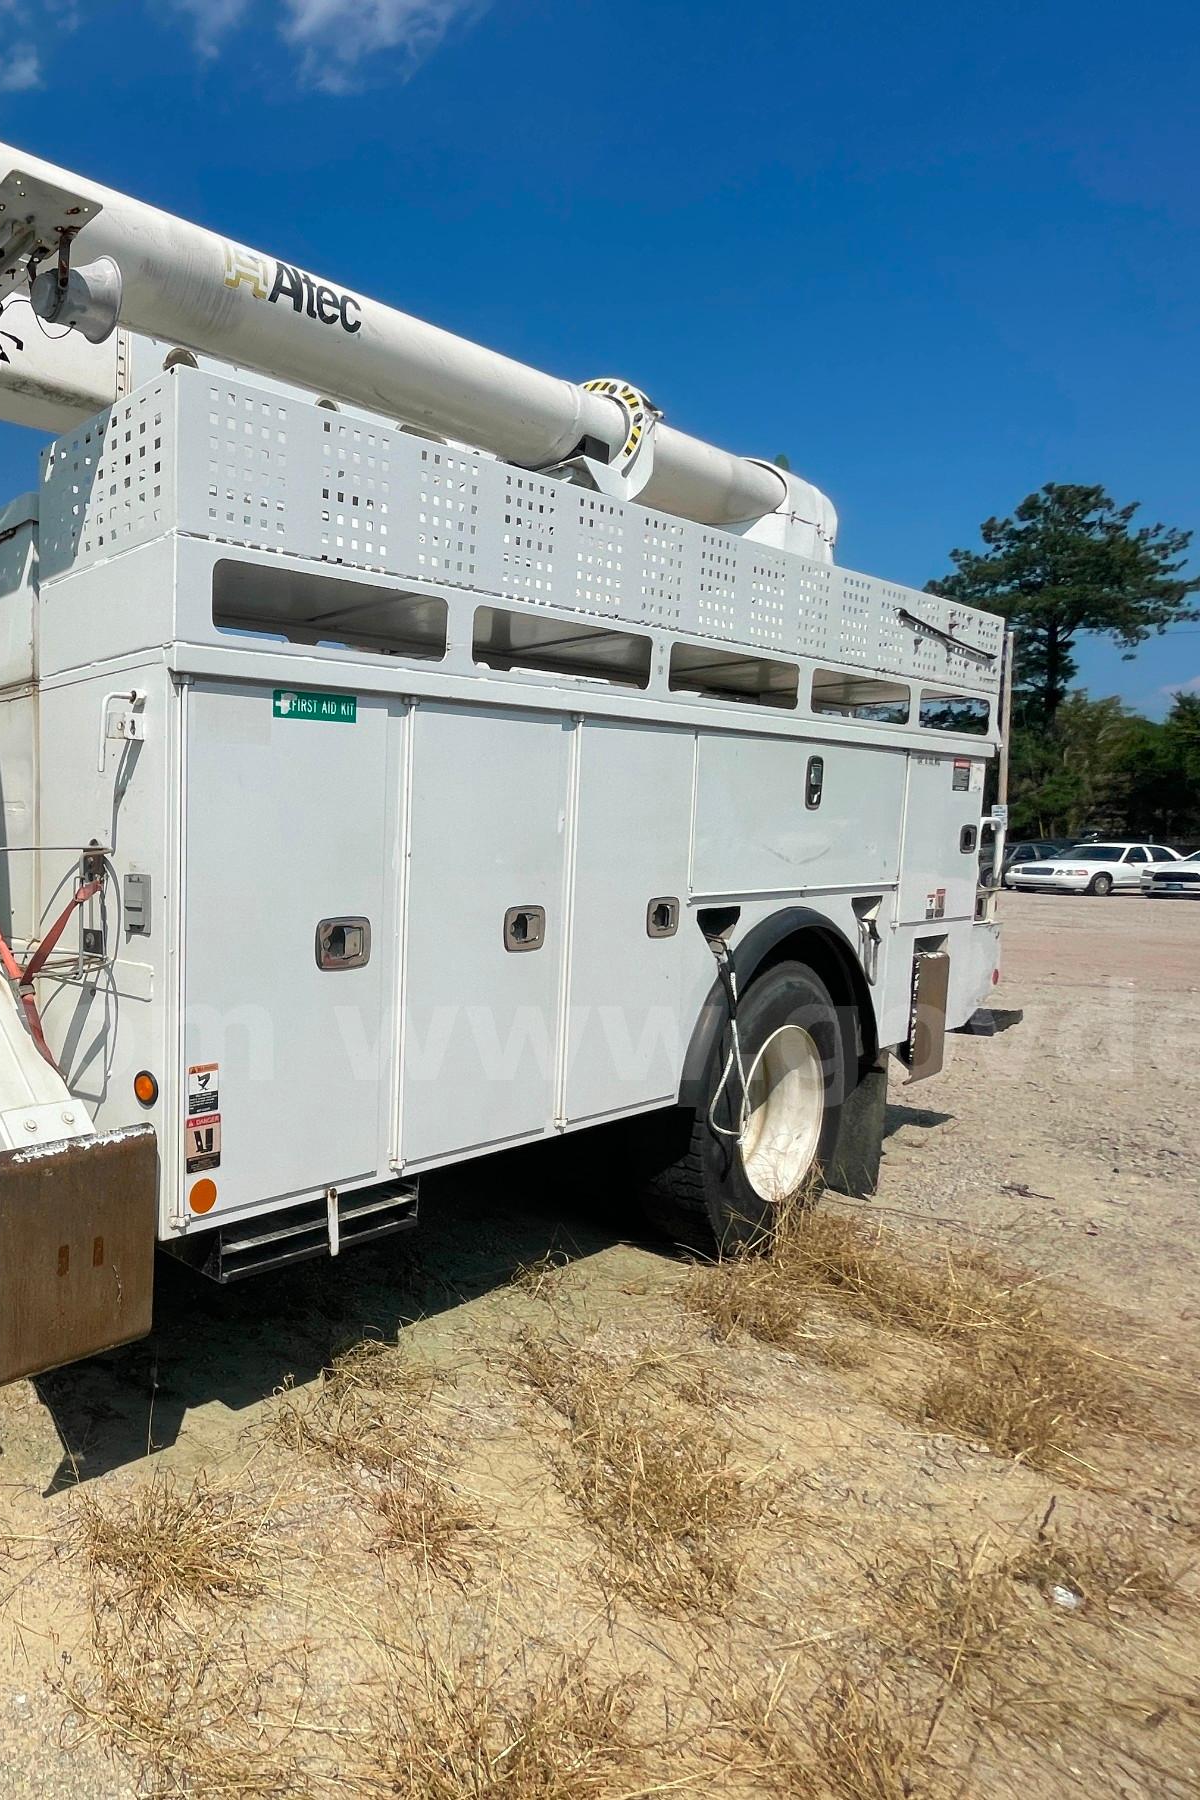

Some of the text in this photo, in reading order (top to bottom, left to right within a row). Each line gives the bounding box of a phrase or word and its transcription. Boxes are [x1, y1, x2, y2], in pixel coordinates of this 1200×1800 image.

[268, 262, 361, 333] Altec
[291, 699, 355, 716] FIRST AID KIT
[196, 1114, 220, 1126] DANGER
